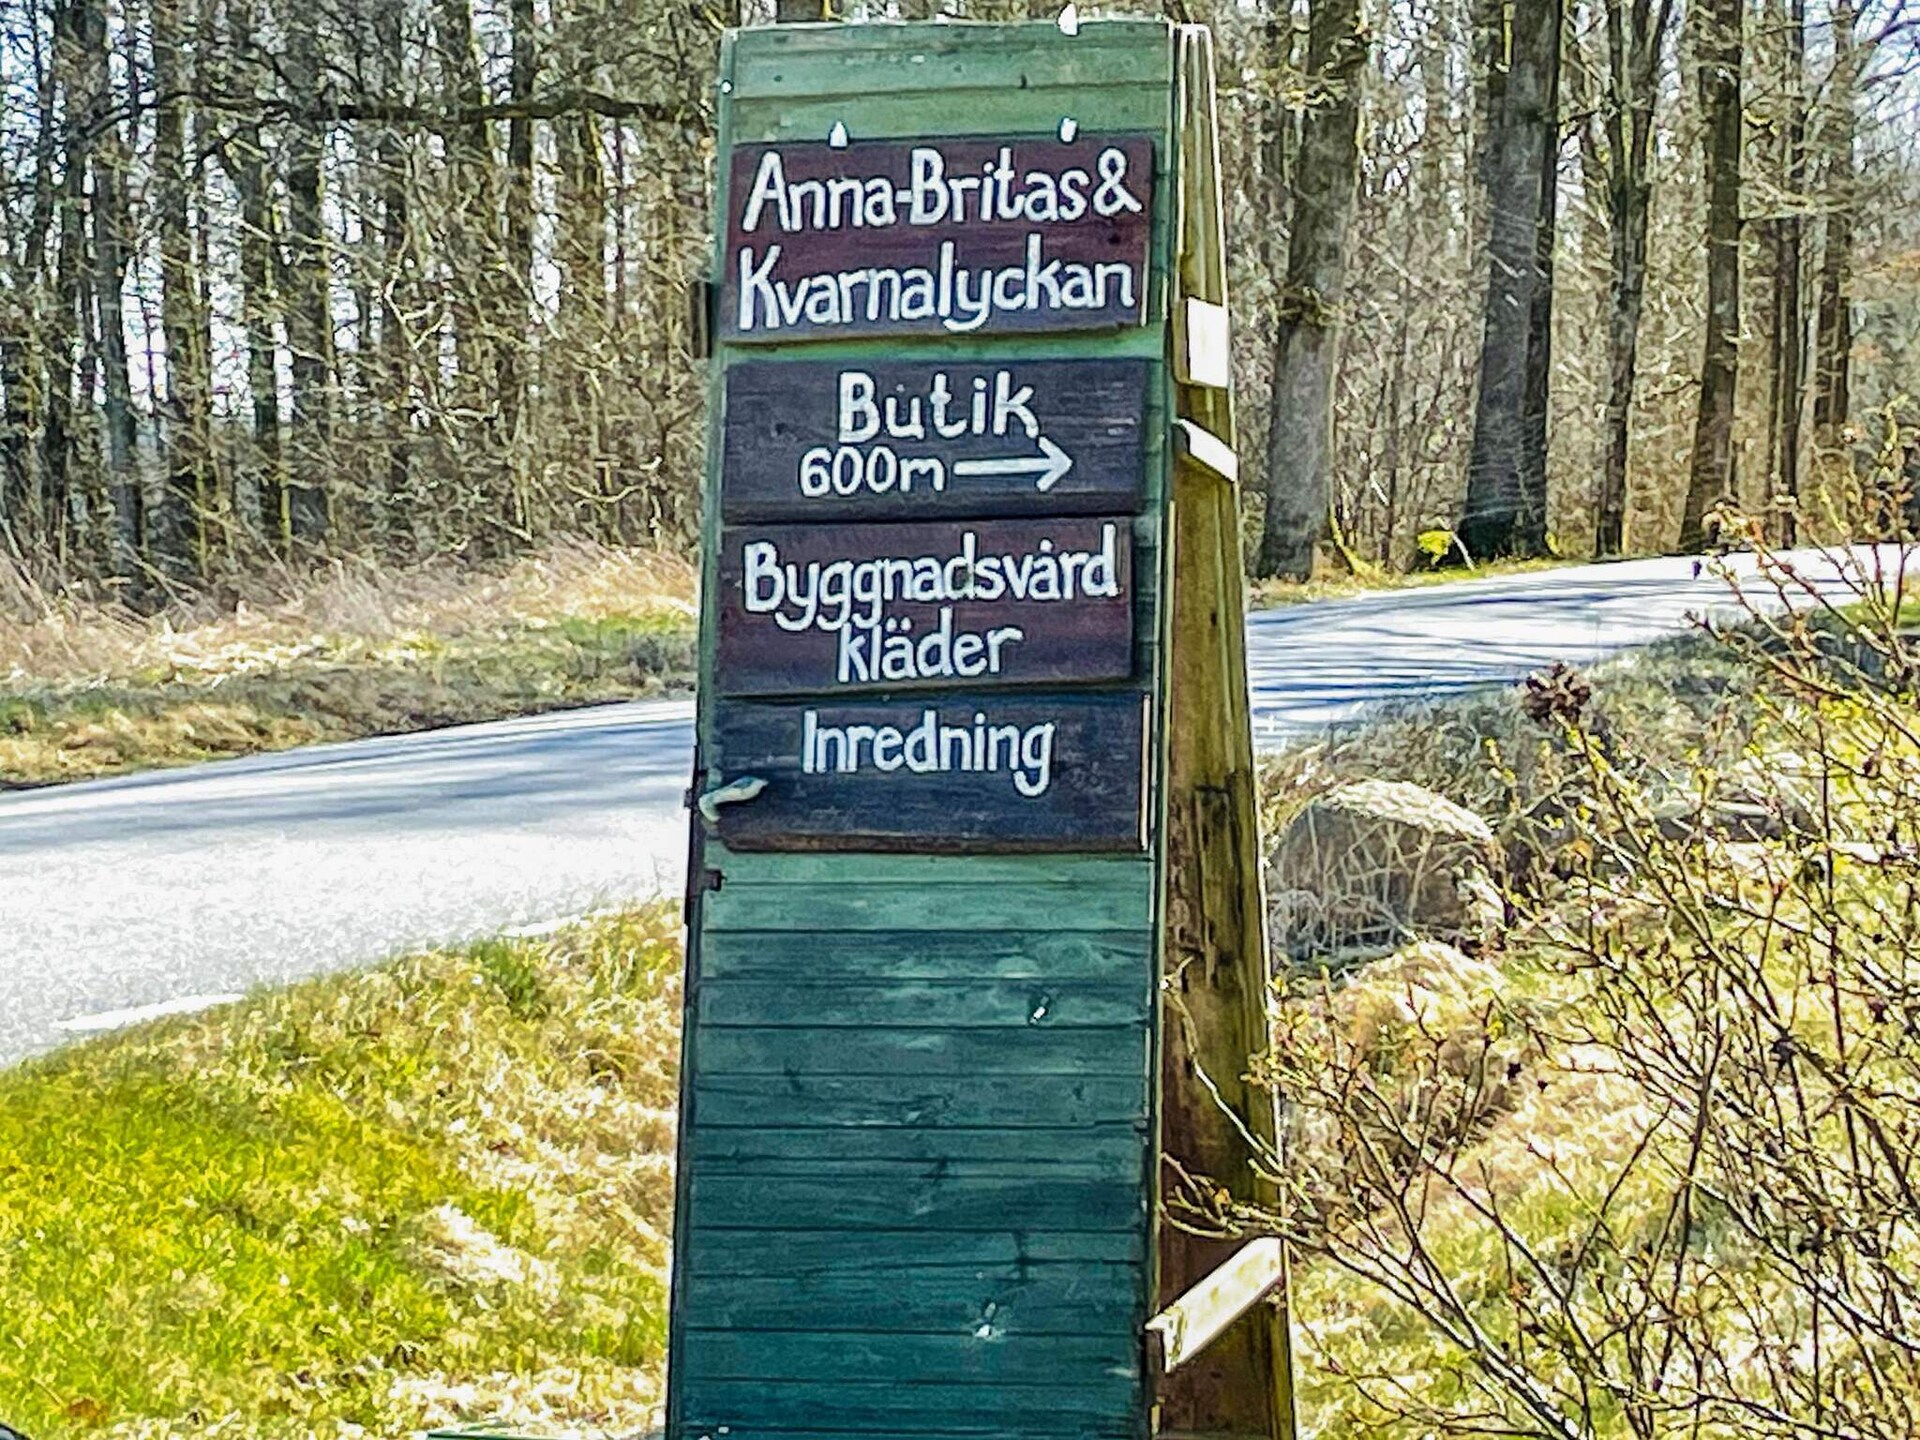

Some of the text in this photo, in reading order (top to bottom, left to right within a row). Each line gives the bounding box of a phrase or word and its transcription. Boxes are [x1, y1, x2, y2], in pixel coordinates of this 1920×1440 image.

[738, 233, 1136, 332] Kvarnalyckan
[837, 371, 1041, 444] Butik
[800, 445, 945, 498] 600m
[744, 523, 1120, 632] Byggnadsvård
[837, 606, 1023, 683] kläder
[802, 709, 1056, 797] Inredning
